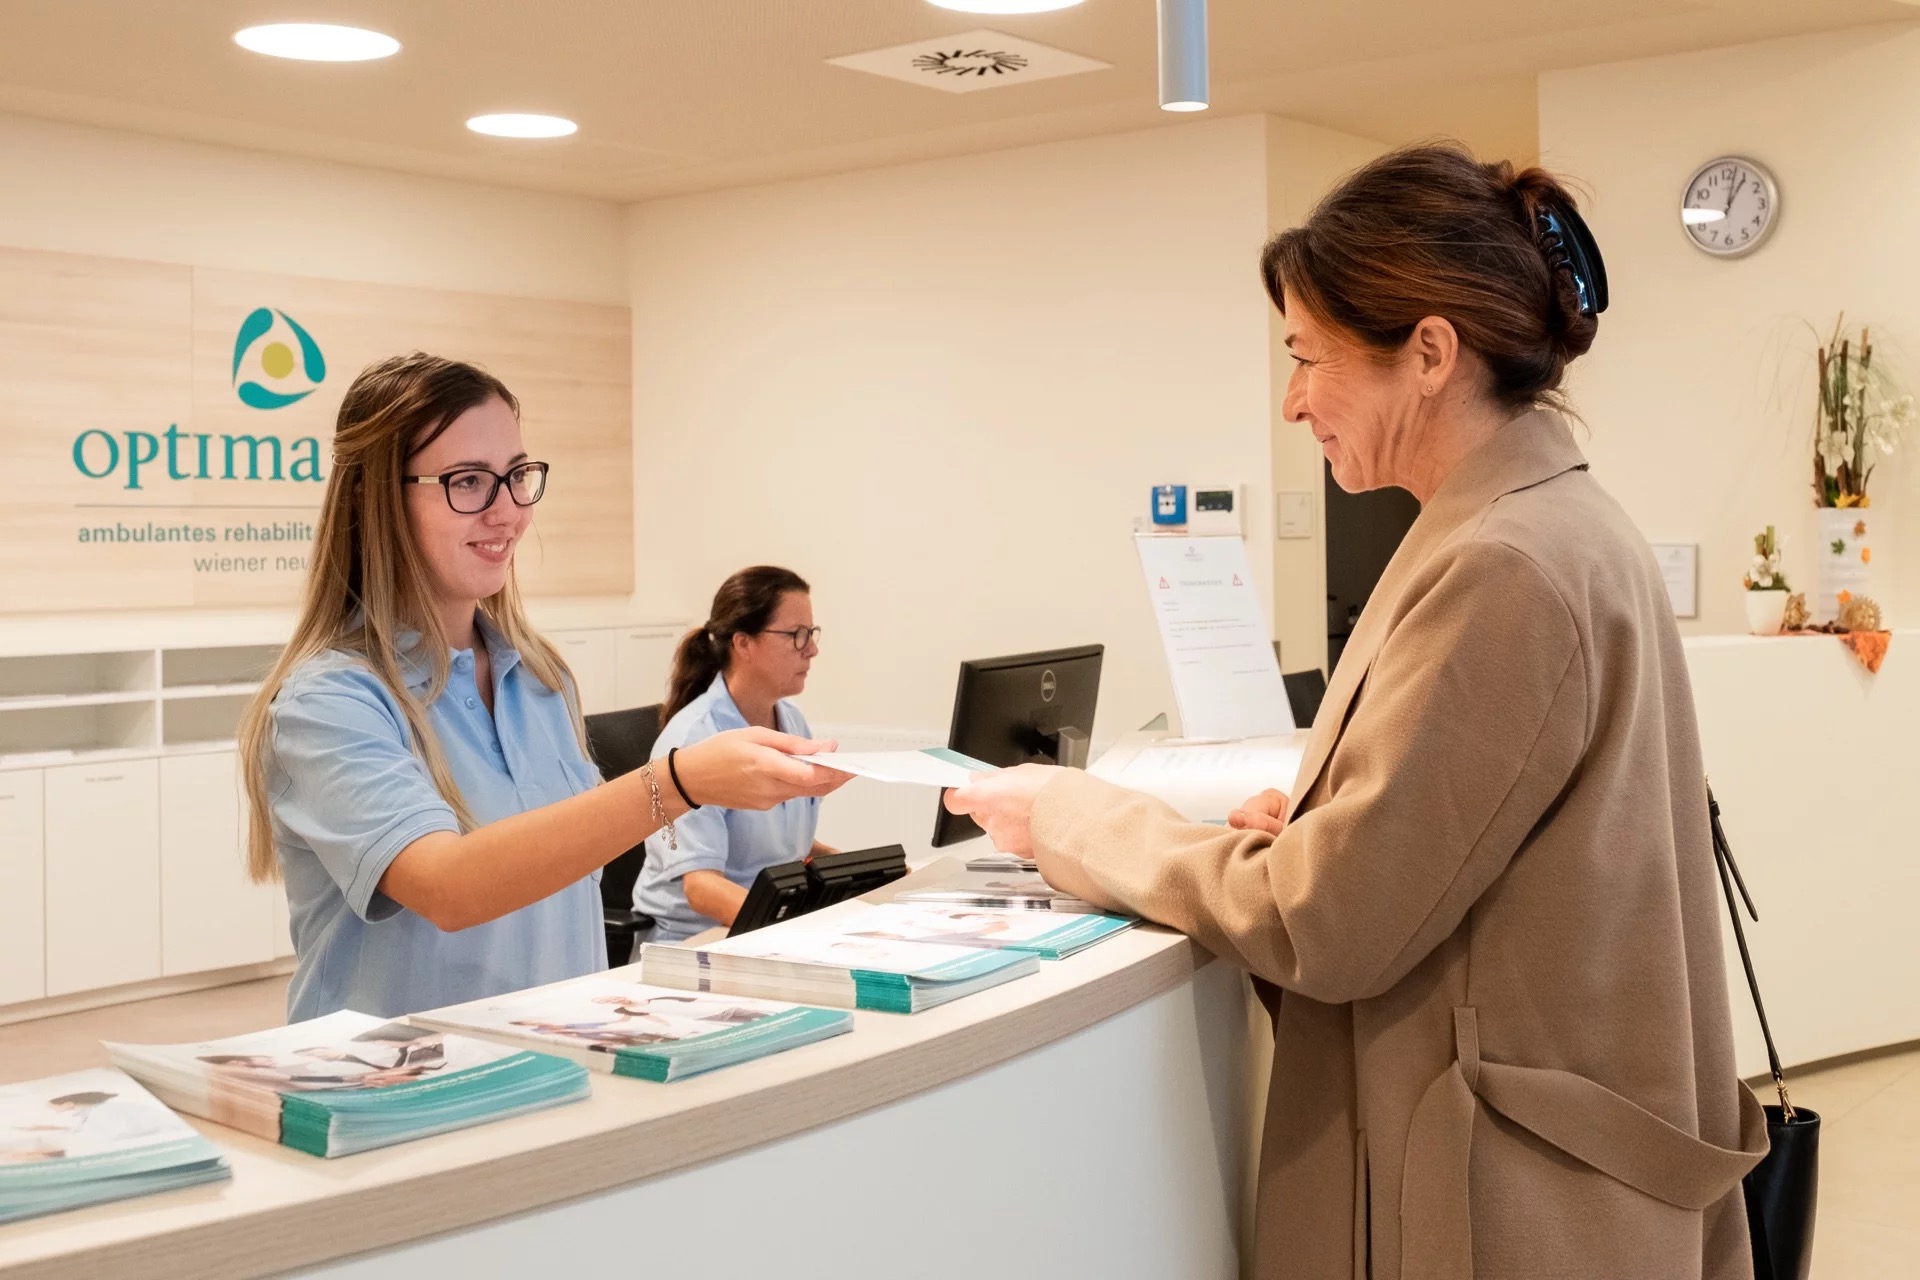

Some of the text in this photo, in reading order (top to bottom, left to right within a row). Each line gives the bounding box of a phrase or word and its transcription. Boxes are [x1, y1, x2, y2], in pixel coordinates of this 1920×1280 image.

[1721, 168, 1733, 181] 12
[1708, 176, 1718, 187] 11
[1752, 181, 1760, 194] 2
[1697, 188, 1710, 200] 10
[1757, 198, 1766, 210] 3
[1752, 216, 1760, 226] 4
[1710, 230, 1719, 242] 7
[1724, 234, 1733, 246] 6
[1741, 228, 1749, 240] 5
[72, 423, 326, 490] optima
[78, 522, 216, 543] ambulantes
[193, 553, 268, 572] wiener
